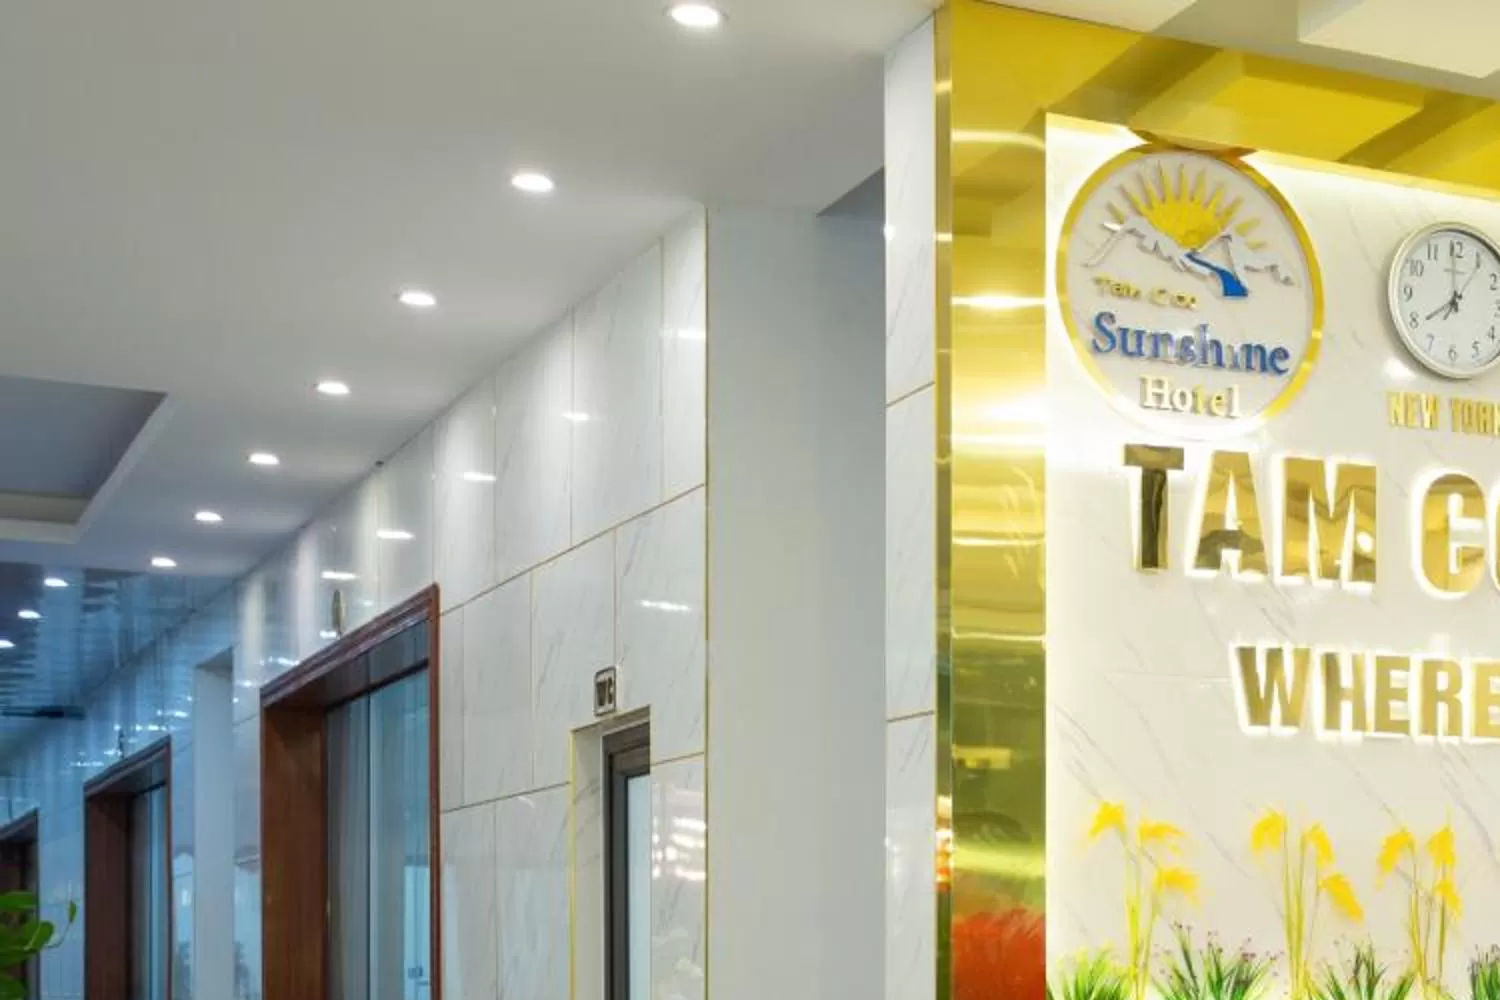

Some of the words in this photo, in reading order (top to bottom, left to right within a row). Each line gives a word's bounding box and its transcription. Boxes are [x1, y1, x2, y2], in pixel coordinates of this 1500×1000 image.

[1092, 311, 1290, 375] Sunshine
[1140, 376, 1240, 418] Hotel
[1387, 391, 1440, 430] NEW
[1123, 443, 1377, 587] TAM
[596, 677, 614, 706] WC
